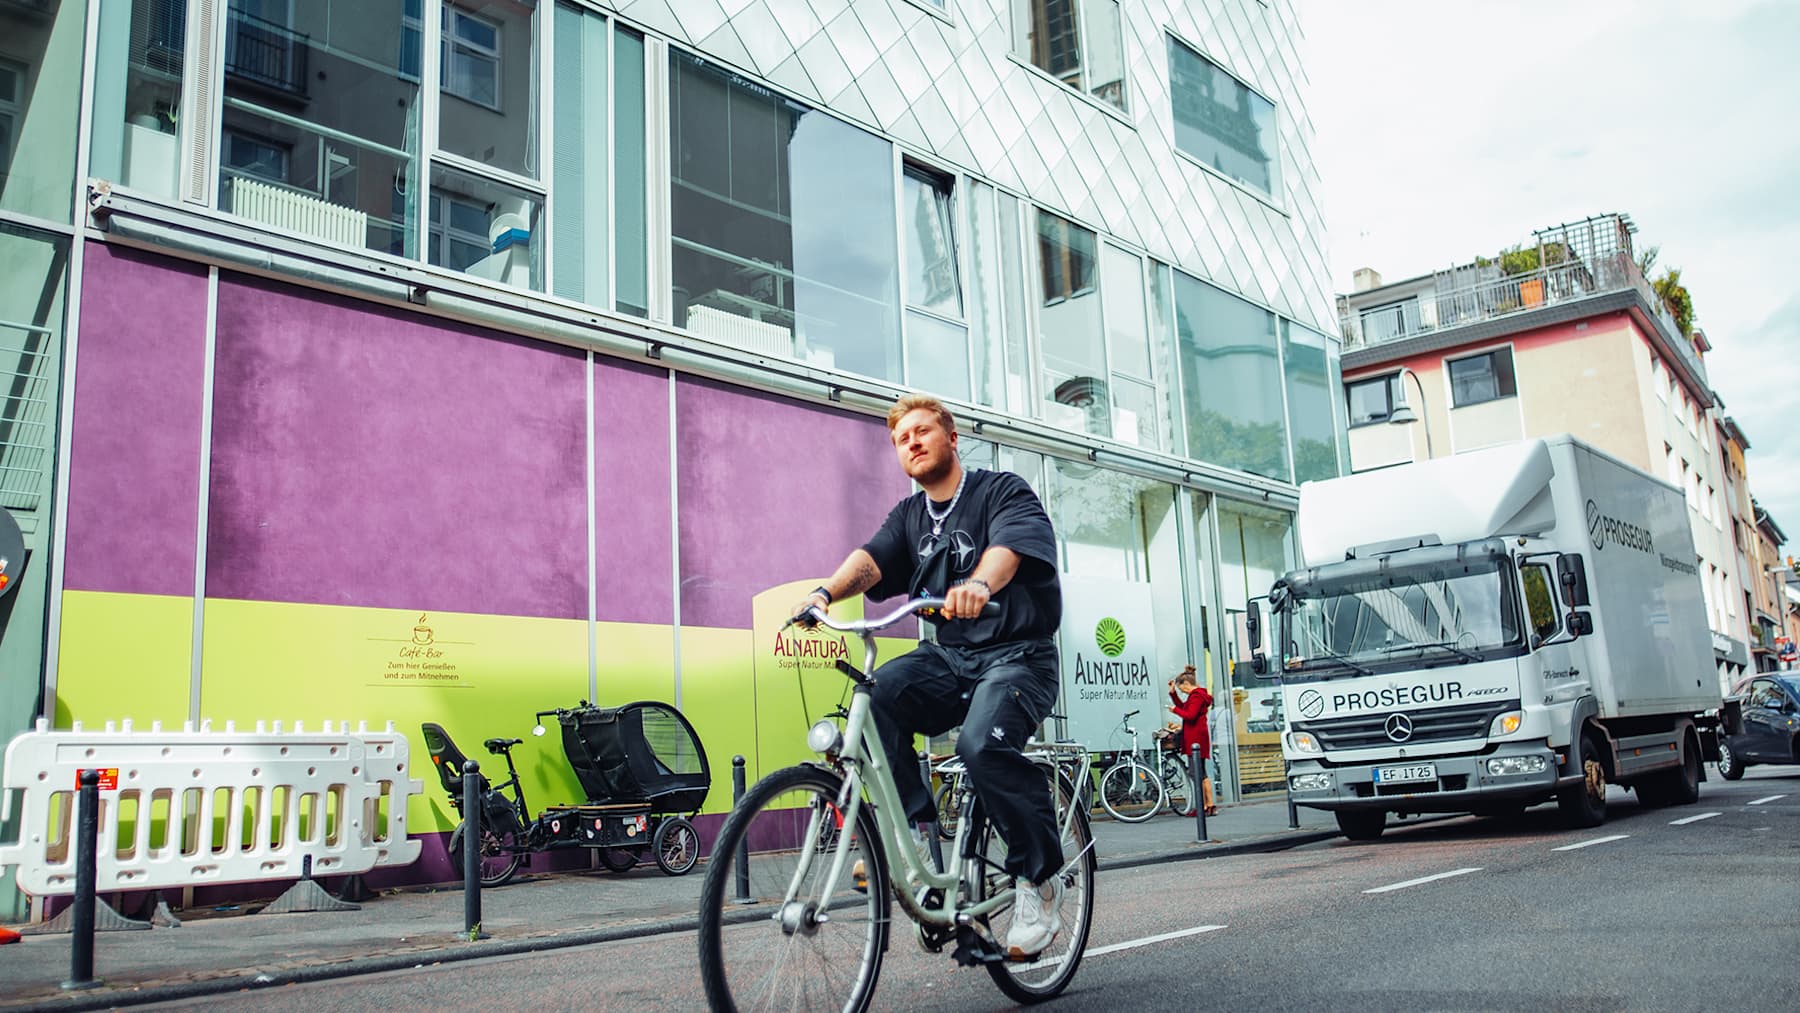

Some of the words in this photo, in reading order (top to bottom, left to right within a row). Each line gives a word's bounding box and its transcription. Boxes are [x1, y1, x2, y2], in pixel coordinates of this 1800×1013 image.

[1602, 515, 1655, 555] PROSEGUR
[774, 631, 849, 659] ALNATURA
[399, 646, 444, 660] Café-Bar
[387, 661, 404, 670] Zum
[405, 662, 420, 670] hier
[422, 662, 456, 671] Genießen
[801, 660, 823, 670] Natur
[1074, 652, 1151, 687] ALNATURA
[383, 672, 399, 680] und
[418, 672, 459, 681] Mitnehmen
[1079, 688, 1103, 702] Super
[1103, 688, 1125, 701] Natur
[1126, 688, 1149, 701] Markt
[1333, 681, 1463, 712] PROSEGUR
[1383, 769, 1397, 780] EF
[1417, 766, 1431, 778] 25
